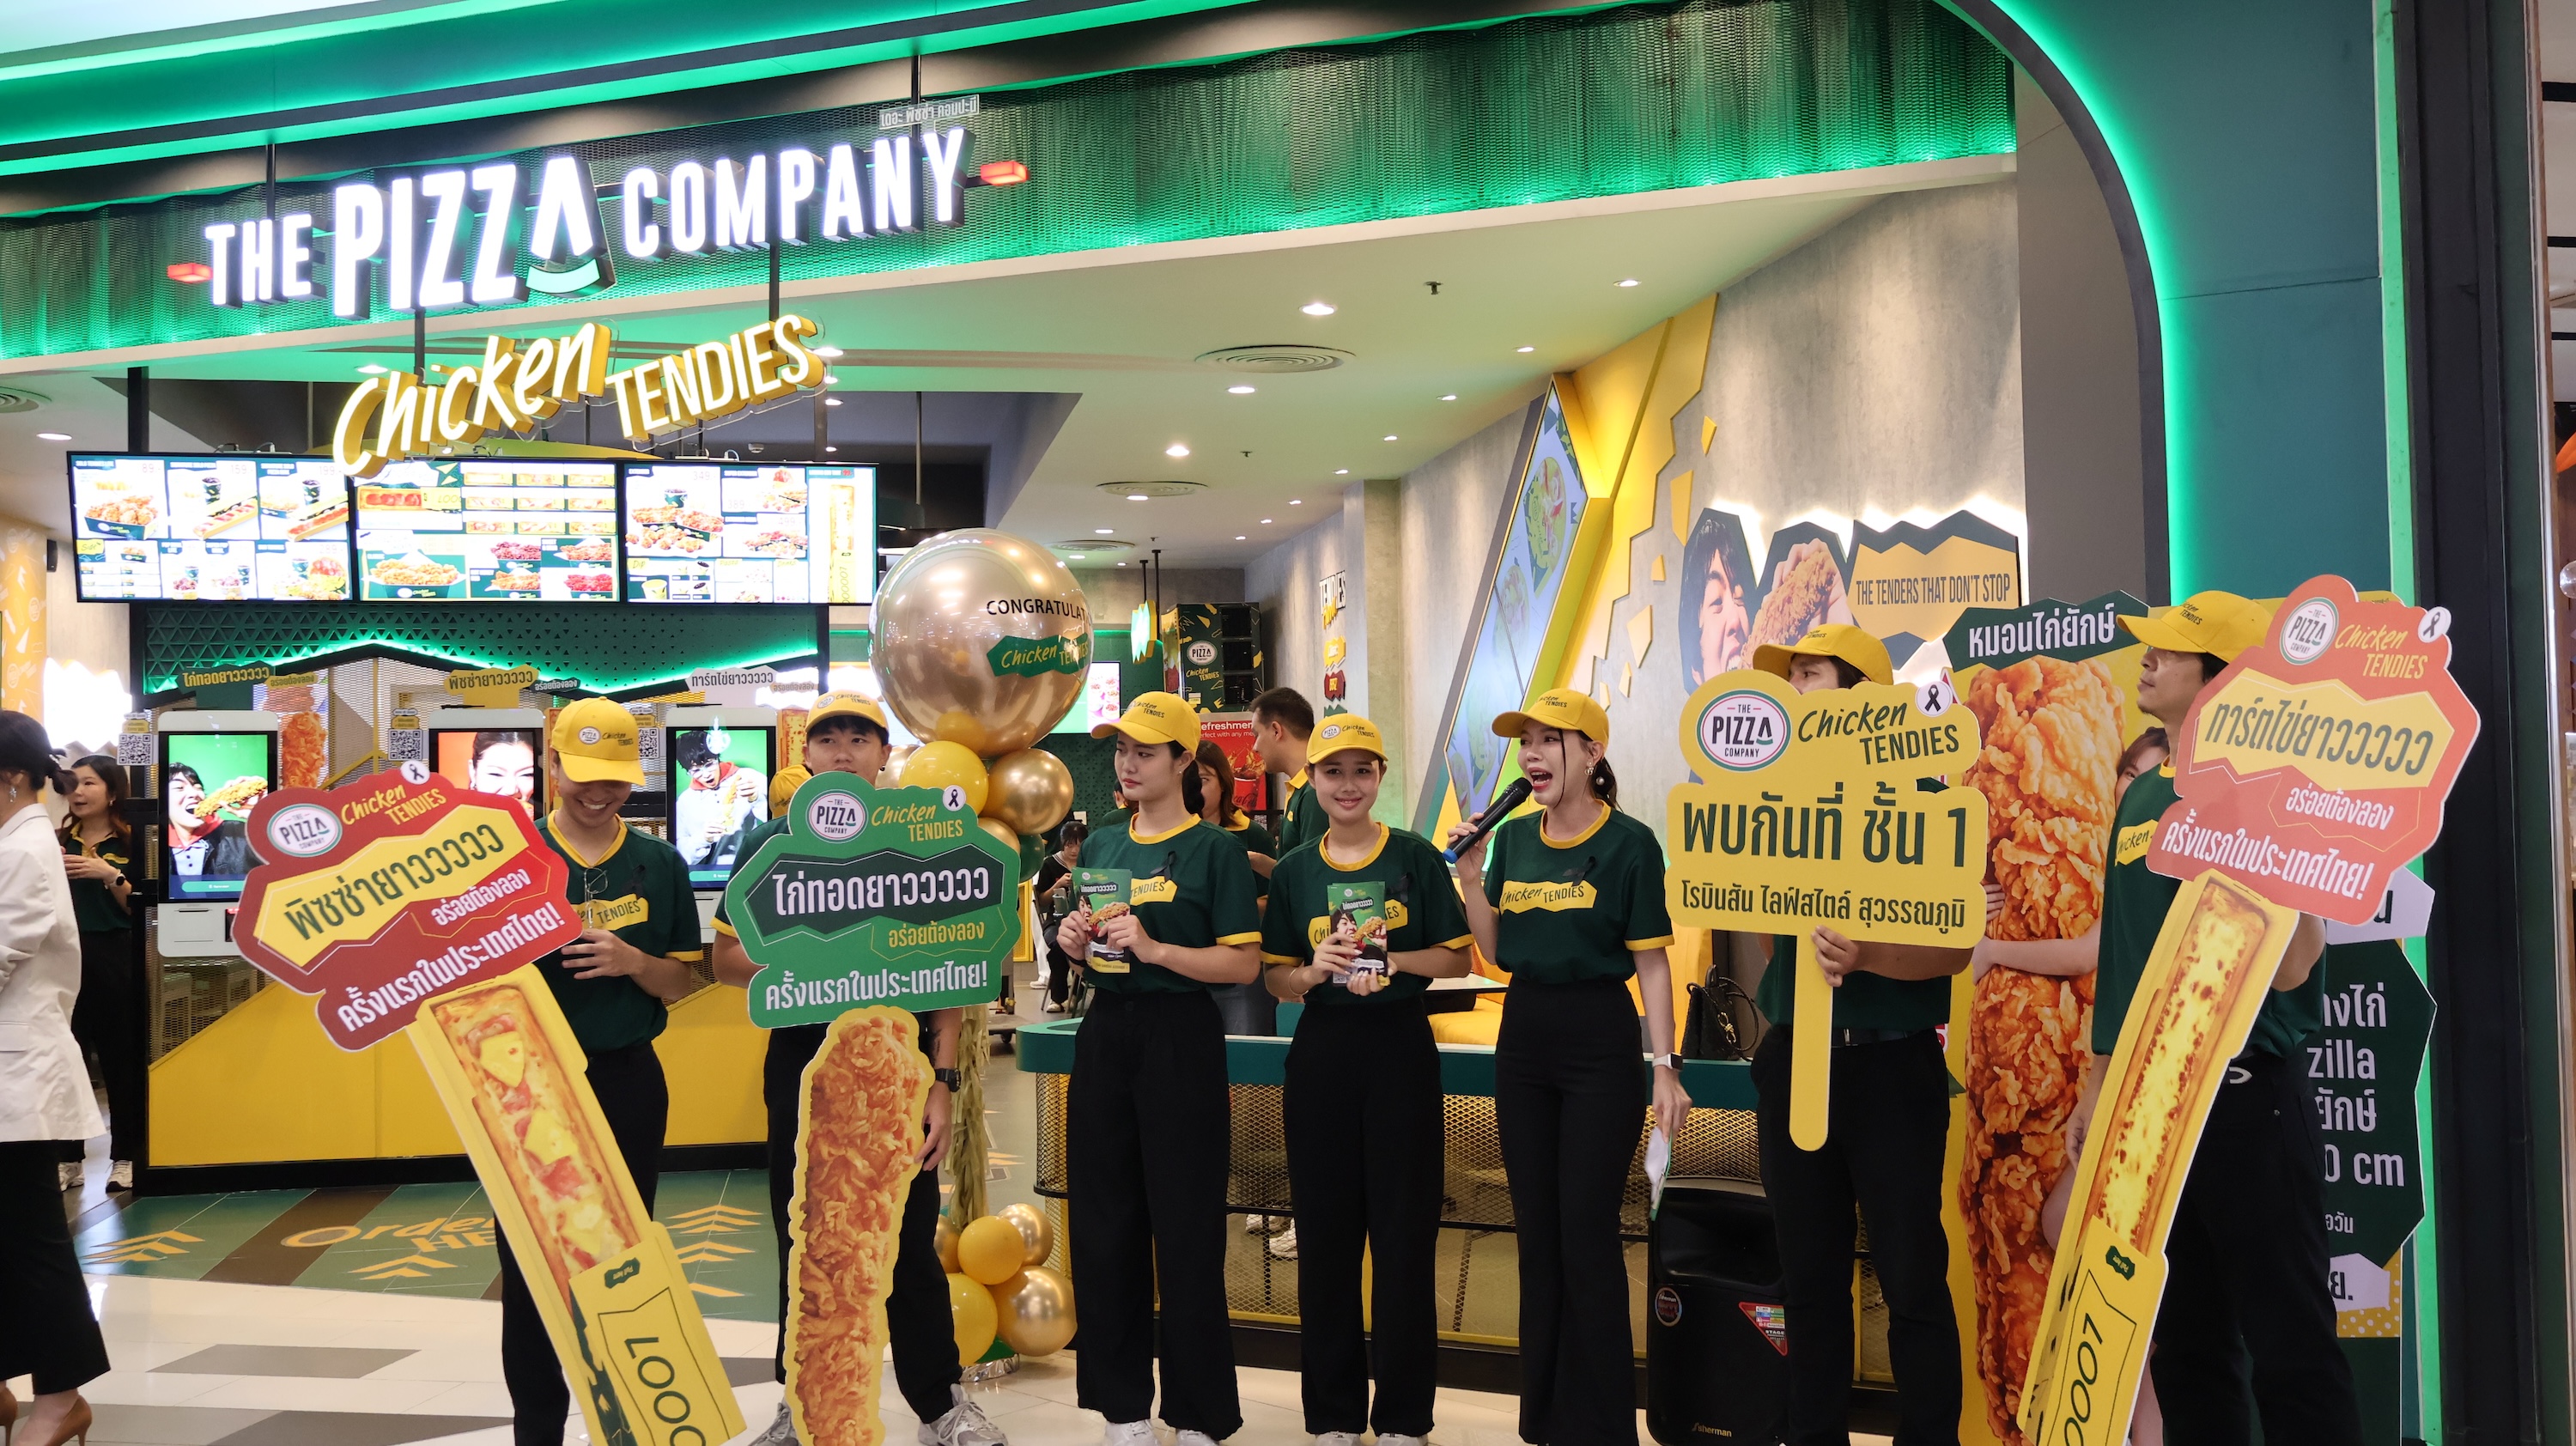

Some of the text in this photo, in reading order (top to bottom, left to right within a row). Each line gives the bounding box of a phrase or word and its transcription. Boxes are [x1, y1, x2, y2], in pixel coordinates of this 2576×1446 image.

[880, 112, 903, 126] เดอะ
[906, 103, 934, 122] พิซซ่า
[205, 128, 969, 317] THE PIZZA COMPANY
[333, 314, 823, 477] Chicken TENDIES
[1856, 573, 2010, 605] THE TENDERS THAT DON'T STOP
[1968, 602, 2116, 659] หมอนไก่ยักษ์
[2180, 609, 2202, 626] TENDIES
[2288, 616, 2325, 646] PIZZA
[2334, 624, 2408, 651] Chicken
[1001, 645, 1057, 668] Chicken
[1192, 649, 1212, 658] PIZZA
[2362, 653, 2428, 679] TENDIES
[1186, 668, 1209, 678] Chicken
[1199, 671, 1220, 682] TENDIES
[1144, 708, 1165, 718] TENDIES
[1738, 704, 1751, 714] THE
[1798, 702, 1908, 743] Chicken
[1200, 721, 1254, 730] efreshmen
[1712, 716, 1774, 745] PIZZA
[2205, 696, 2434, 777] ทาร์ตไข่ยาววววว
[1724, 747, 1760, 758] COMPANY
[1860, 724, 1960, 765] TENDIES
[341, 784, 408, 826] Chicken
[385, 787, 447, 826] TENDIES
[817, 806, 857, 827] PIZZA
[872, 803, 937, 827] Chicken
[2285, 786, 2395, 830] อร่อยต้องลอง
[279, 817, 330, 846] PIZZA
[824, 826, 848, 835] COMPANY
[908, 819, 963, 842] TENDIES
[1683, 781, 1967, 867] พบกันที่ ชั้น 1
[2160, 809, 2374, 900] ครั้งแรกในประเทศไทย!
[283, 823, 505, 941] พิซซ่ายาววววว
[772, 866, 989, 916] ไก่ทอดยาววววว
[1130, 881, 1165, 899] TENDIES
[1501, 884, 1584, 907] Chicken TENDIES
[431, 868, 532, 927] อร่อยต้องลอง
[597, 900, 641, 924] TENDIES
[1681, 879, 1965, 935] โรบินสัน ไลฟ์สไตล์ สุวรรณภูมิ
[888, 920, 986, 948] อร่อยต้องลอง
[337, 901, 567, 1033] ครั้งแรกในประเทศไทย!
[765, 960, 988, 1011] ครั้งแรกในประเทศไทย!
[2306, 1039, 2377, 1079] zilla
[2316, 1087, 2378, 1133] ยักษ์
[2324, 1143, 2404, 1187] 0 cm
[2326, 1212, 2354, 1234] อวัน
[410, 1230, 496, 1253] HE
[1697, 1424, 1733, 1438] sherman
